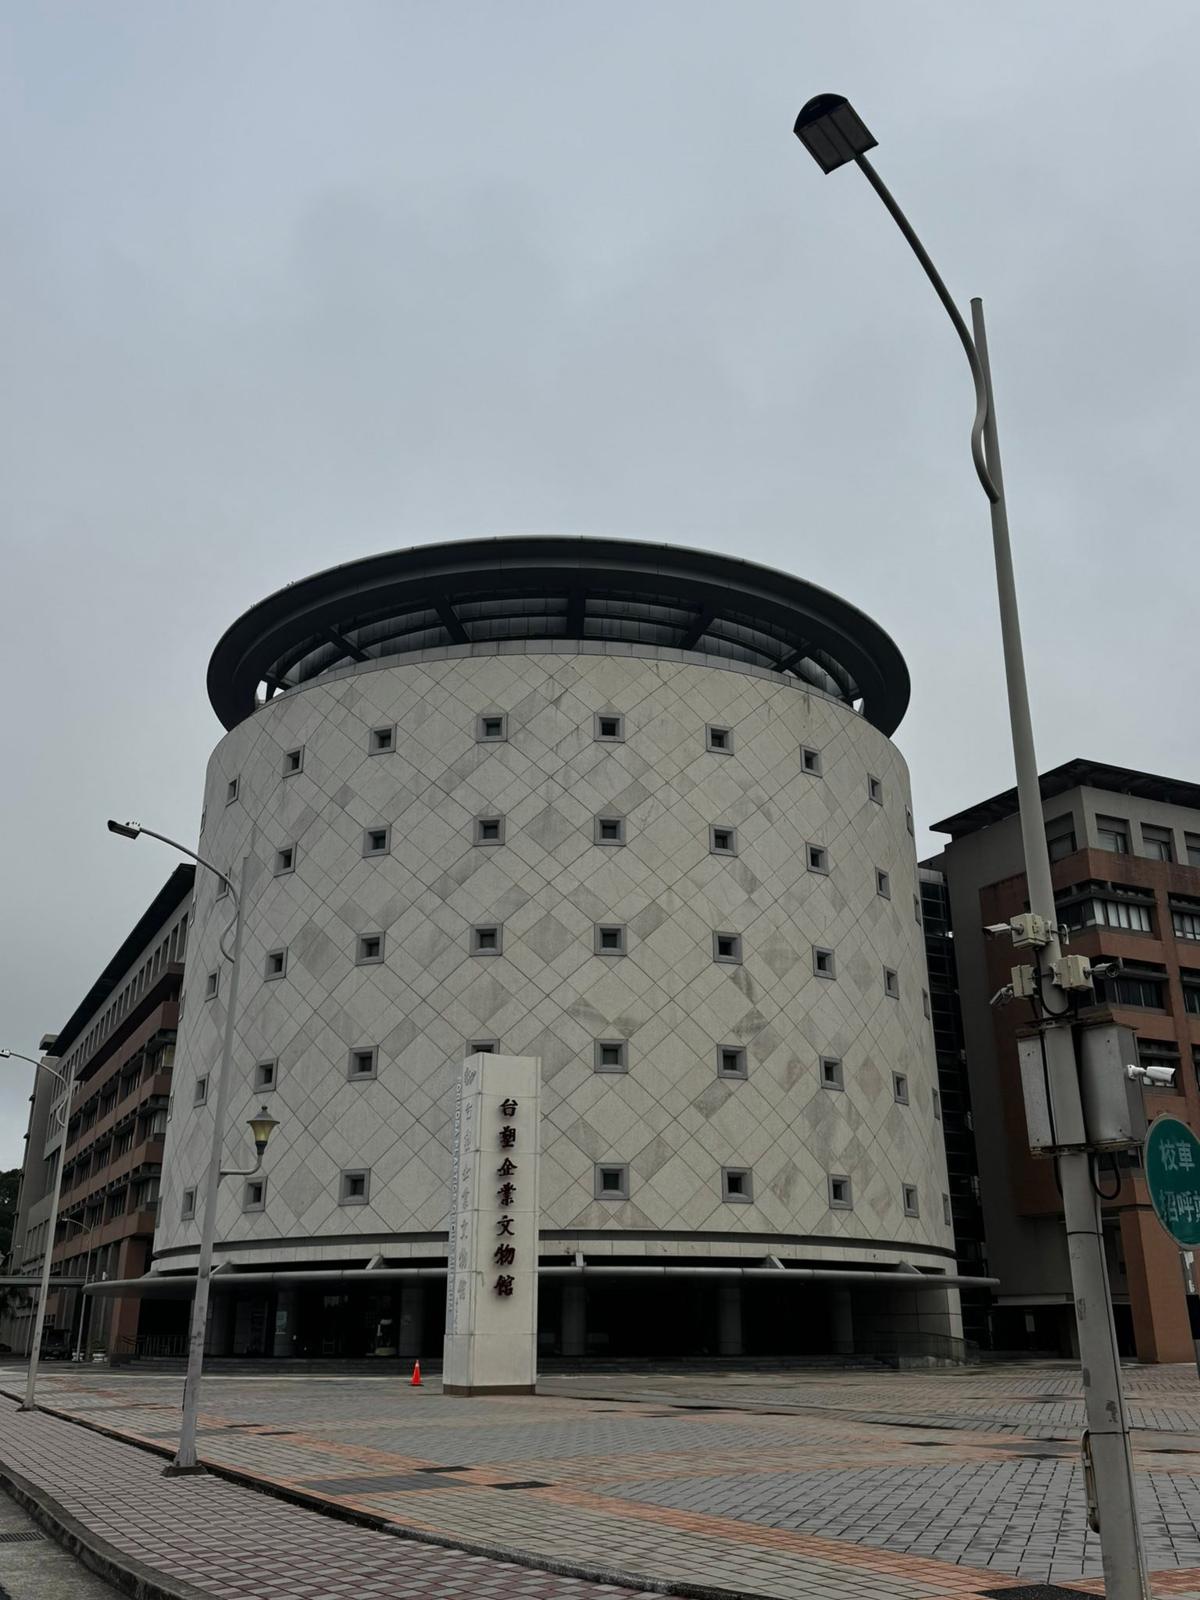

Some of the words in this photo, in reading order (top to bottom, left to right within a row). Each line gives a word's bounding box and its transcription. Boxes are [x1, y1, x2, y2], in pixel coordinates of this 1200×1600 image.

[493, 1098, 519, 1297] 台塑企業文物館
[1159, 1139, 1196, 1171] 校車
